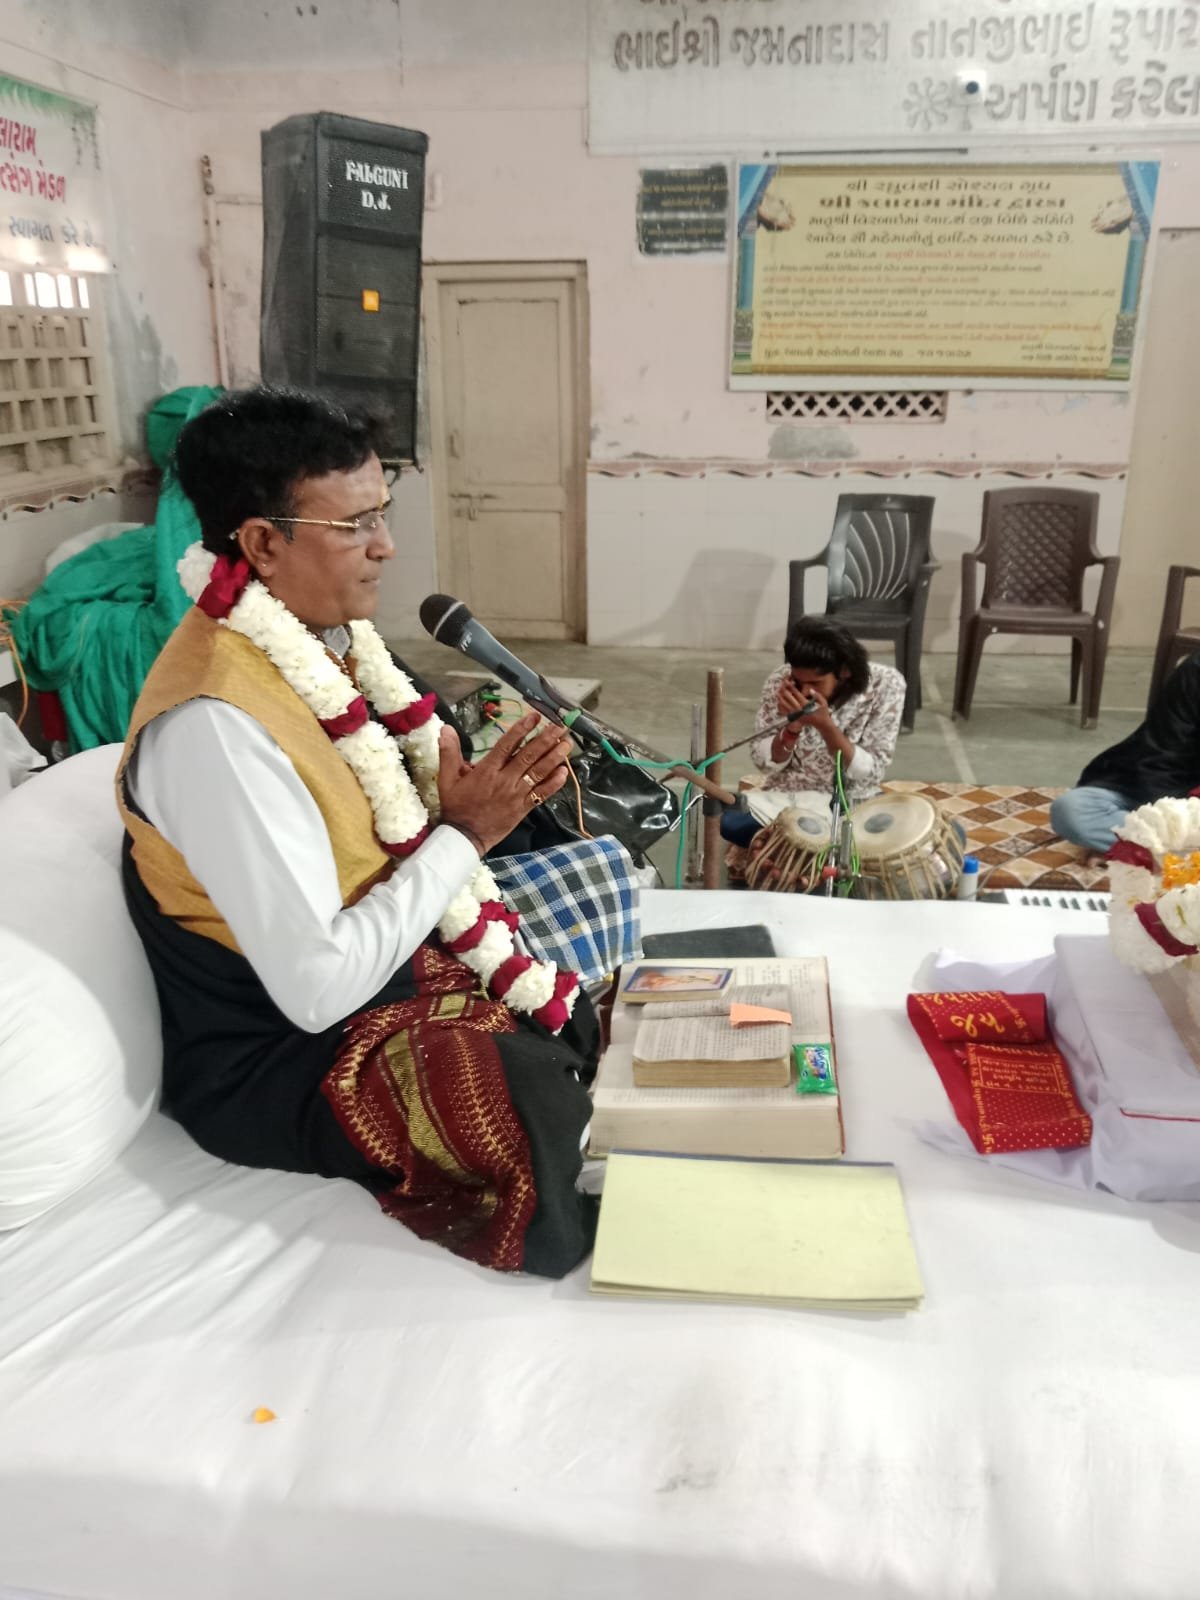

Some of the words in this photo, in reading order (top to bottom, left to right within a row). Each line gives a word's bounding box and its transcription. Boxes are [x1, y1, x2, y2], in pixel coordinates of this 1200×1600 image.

[983, 62, 1099, 122] અર્પણ
[345, 159, 409, 190] FALGUNI
[361, 189, 391, 211] D.J.
